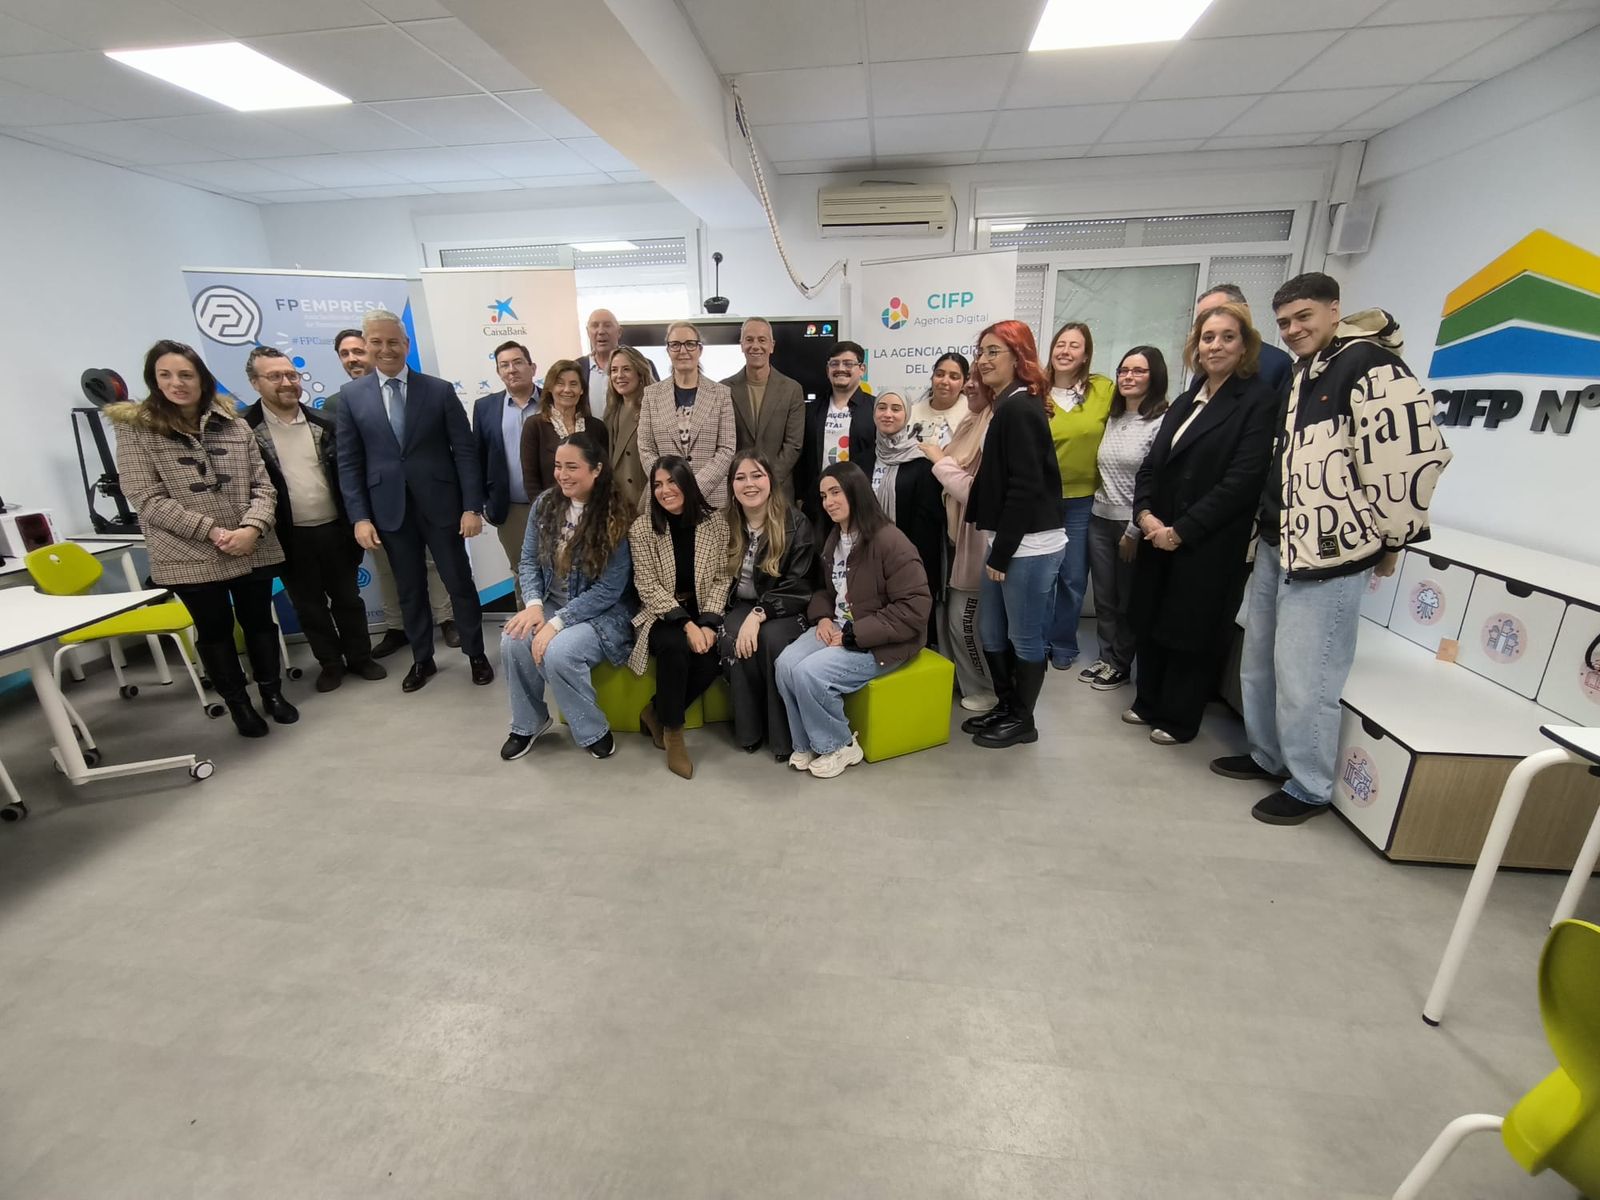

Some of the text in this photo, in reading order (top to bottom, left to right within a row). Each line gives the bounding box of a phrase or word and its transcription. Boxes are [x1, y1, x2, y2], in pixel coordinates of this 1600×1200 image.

[275, 298, 388, 313] FPEMPRESA
[927, 291, 974, 309] CIFP
[914, 314, 989, 327] Agencia Digital
[483, 326, 528, 337] CaixaBank
[873, 349, 888, 359] LA
[890, 346, 944, 358] AGENCIA
[905, 364, 929, 374] DEL
[1431, 389, 1524, 429] CIFP
[963, 597, 978, 634] HARVARD
